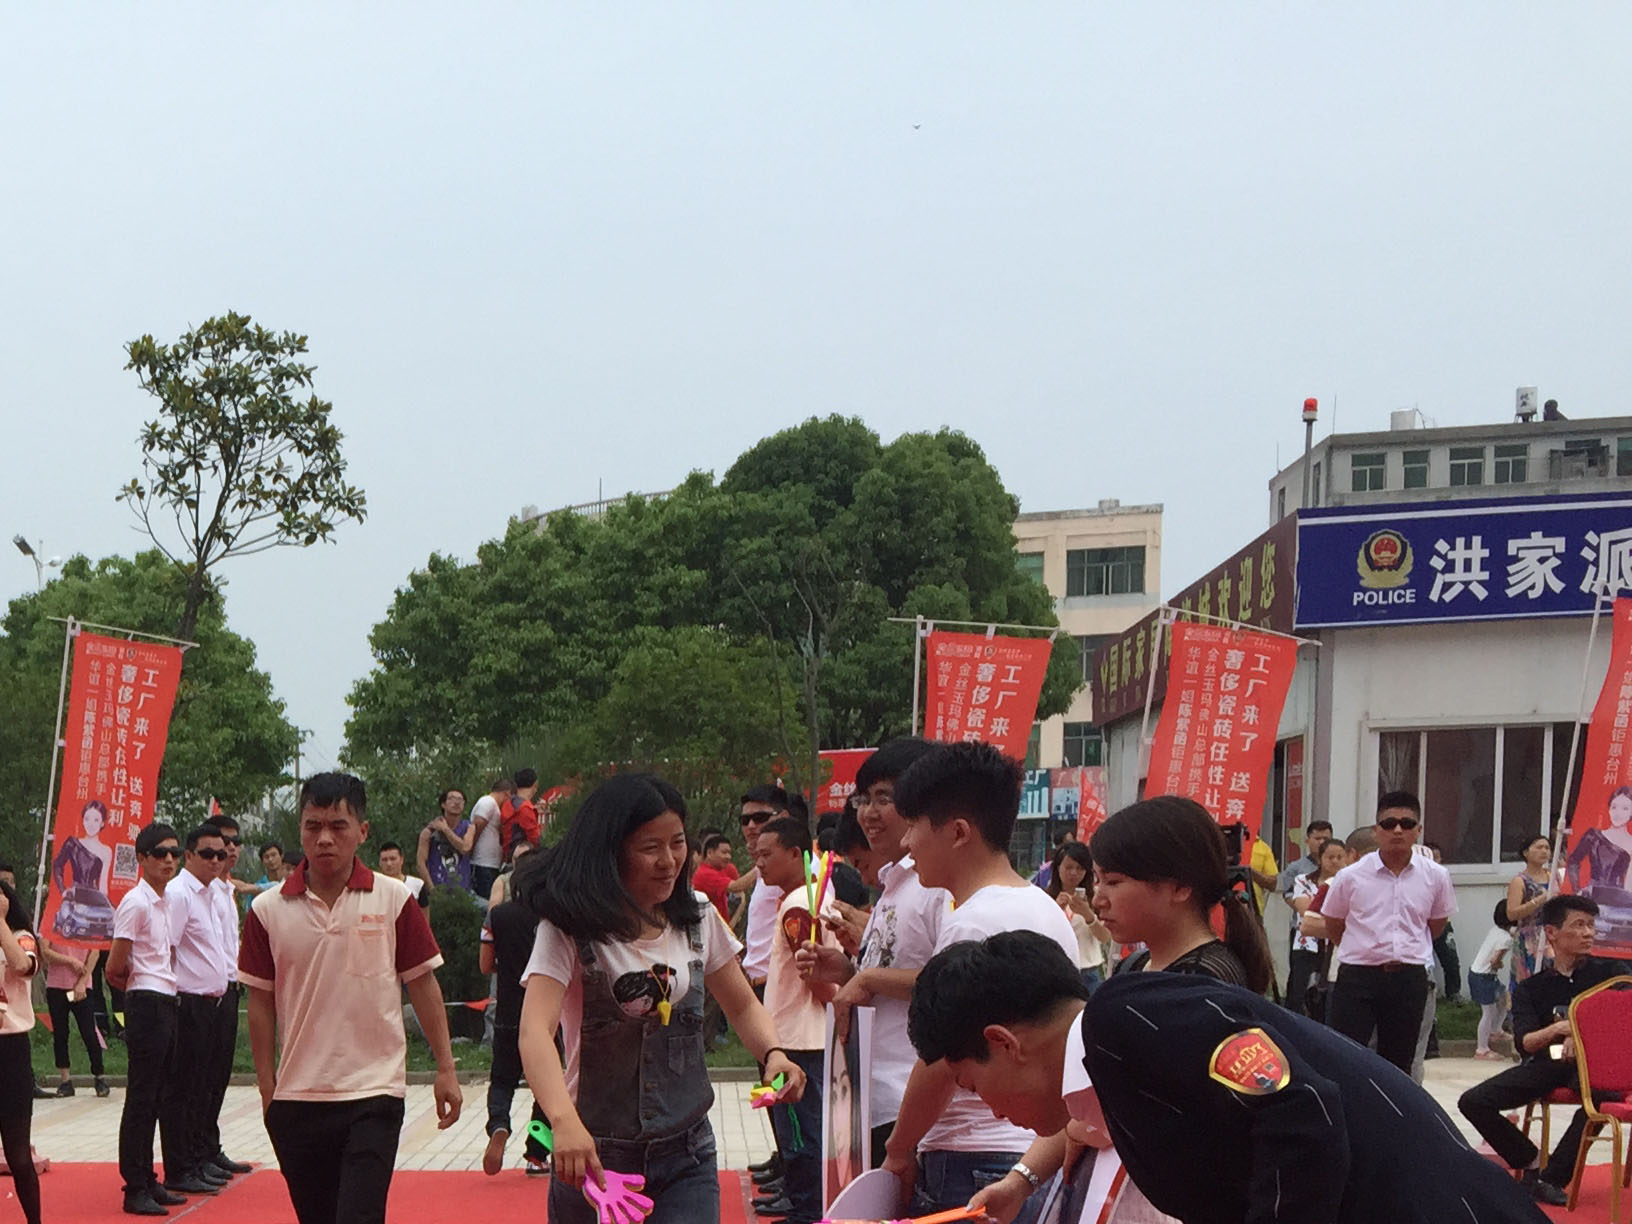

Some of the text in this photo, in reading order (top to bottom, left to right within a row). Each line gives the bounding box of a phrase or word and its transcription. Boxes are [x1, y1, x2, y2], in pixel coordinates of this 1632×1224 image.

[1353, 589, 1416, 606] POLICE
[132, 668, 158, 760] 工厂来了
[1240, 653, 1270, 751] 工厂来了
